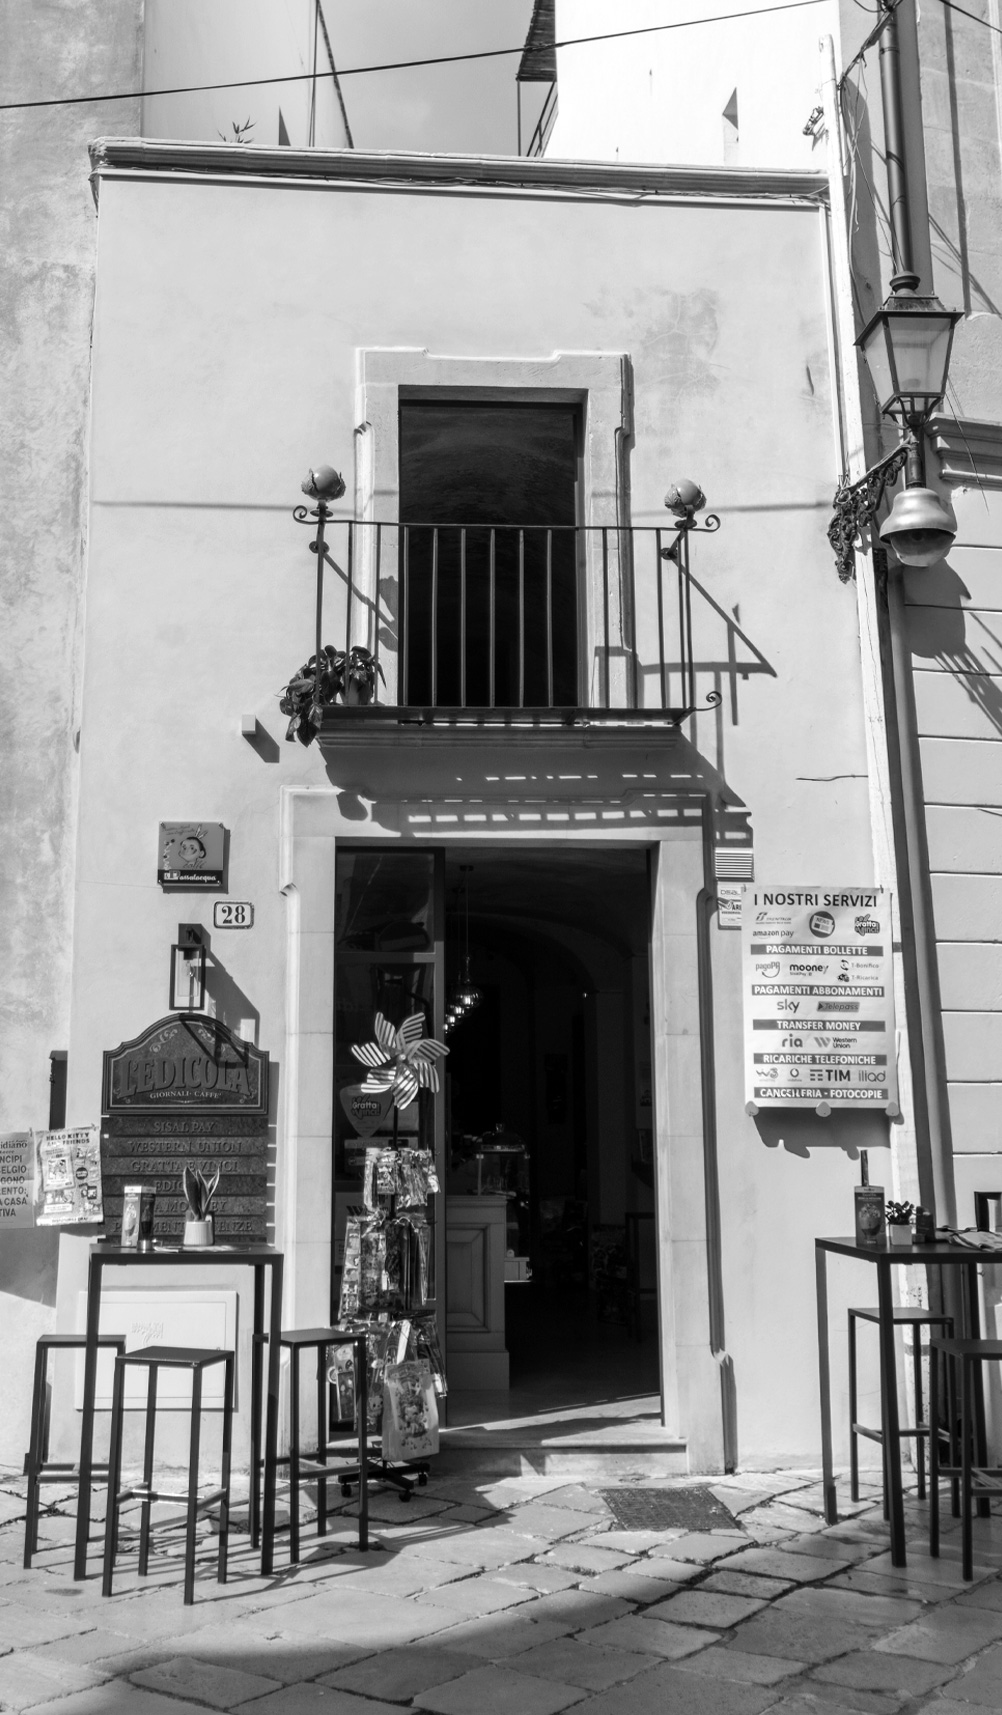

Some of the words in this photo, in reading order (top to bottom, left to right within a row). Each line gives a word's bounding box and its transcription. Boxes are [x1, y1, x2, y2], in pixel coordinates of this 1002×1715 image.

[754, 893, 758, 906] I
[763, 893, 819, 906] NOSTRI
[823, 894, 877, 907] SERVIZI
[221, 905, 246, 924] 28
[781, 930, 794, 938] pay
[766, 945, 821, 954] PAGAMENTI
[823, 947, 868, 955] BOLLETTE
[789, 964, 829, 974] mooney
[754, 986, 811, 995] PAGAMENTI
[812, 987, 883, 996] ABBONAMENTI
[777, 999, 801, 1013] sky
[777, 1021, 824, 1030] TRANSFER
[826, 1022, 861, 1031] MONEY
[782, 1033, 803, 1048] ria
[763, 1055, 813, 1064] RICARICHE
[815, 1056, 876, 1065] TELEFONICHE
[117, 1057, 252, 1098] L'EDICOLA
[826, 1069, 851, 1082] TIM
[859, 1070, 886, 1082] iliad
[150, 1091, 189, 1099] GIORNALI
[830, 1090, 883, 1099] FOTOCOPIE
[153, 1121, 188, 1134] SISAL
[191, 1122, 216, 1134] PAY
[129, 1141, 192, 1153] WESTERN
[199, 1142, 242, 1153] UNION
[0, 1165, 27, 1174] ELGIO
[131, 1160, 184, 1173] GRATTA
[200, 1161, 238, 1173] VINCI
[0, 1187, 27, 1195] ENTO:
[4, 1196, 27, 1205] CASA
